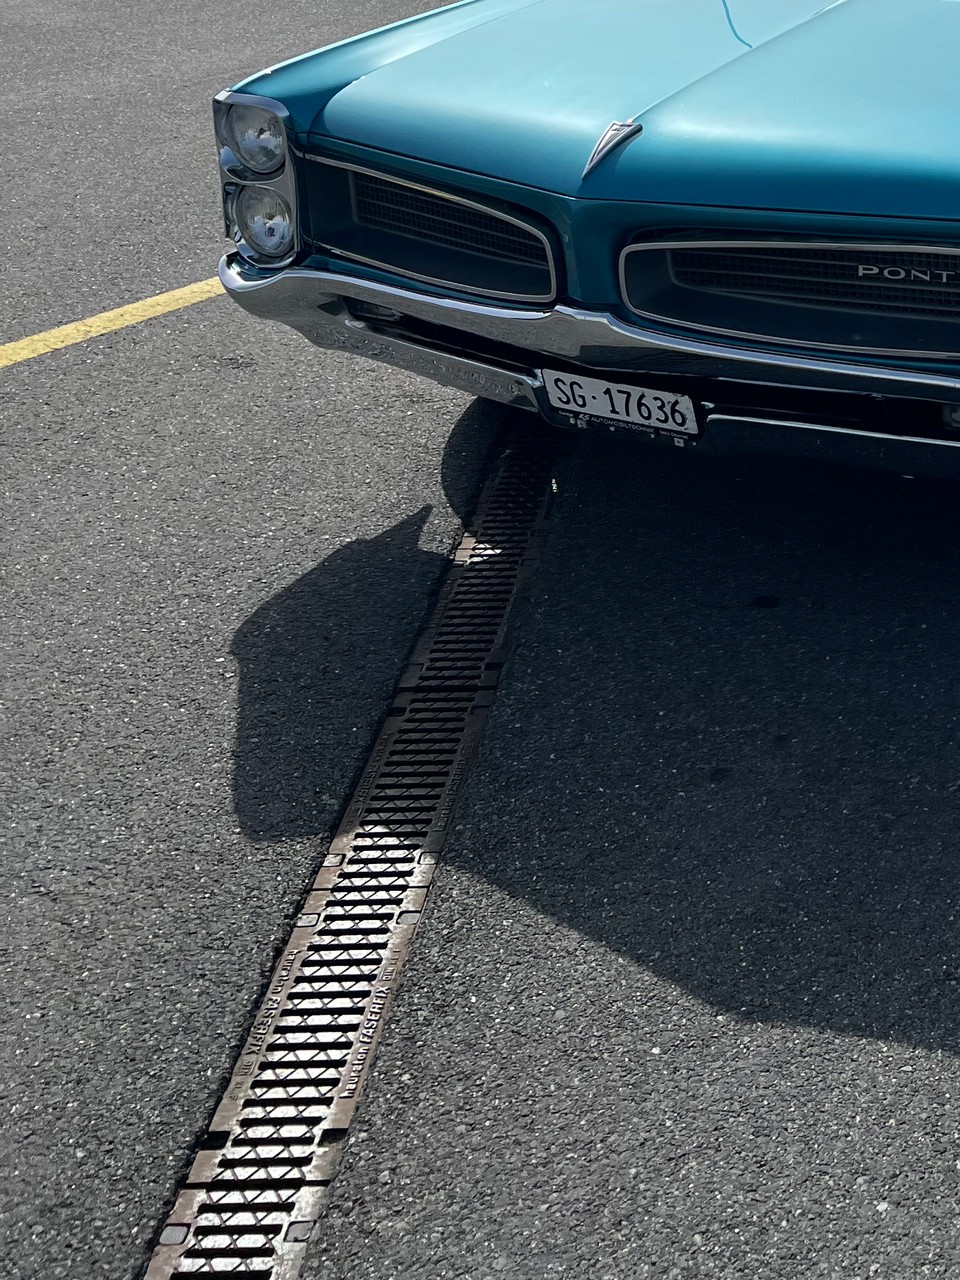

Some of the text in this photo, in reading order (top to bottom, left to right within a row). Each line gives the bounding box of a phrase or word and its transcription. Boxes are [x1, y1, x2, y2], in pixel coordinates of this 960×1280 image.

[602, 386, 689, 429] 17636
[339, 1046, 370, 1099] hauraton
[359, 985, 391, 1044] FASERFIX
